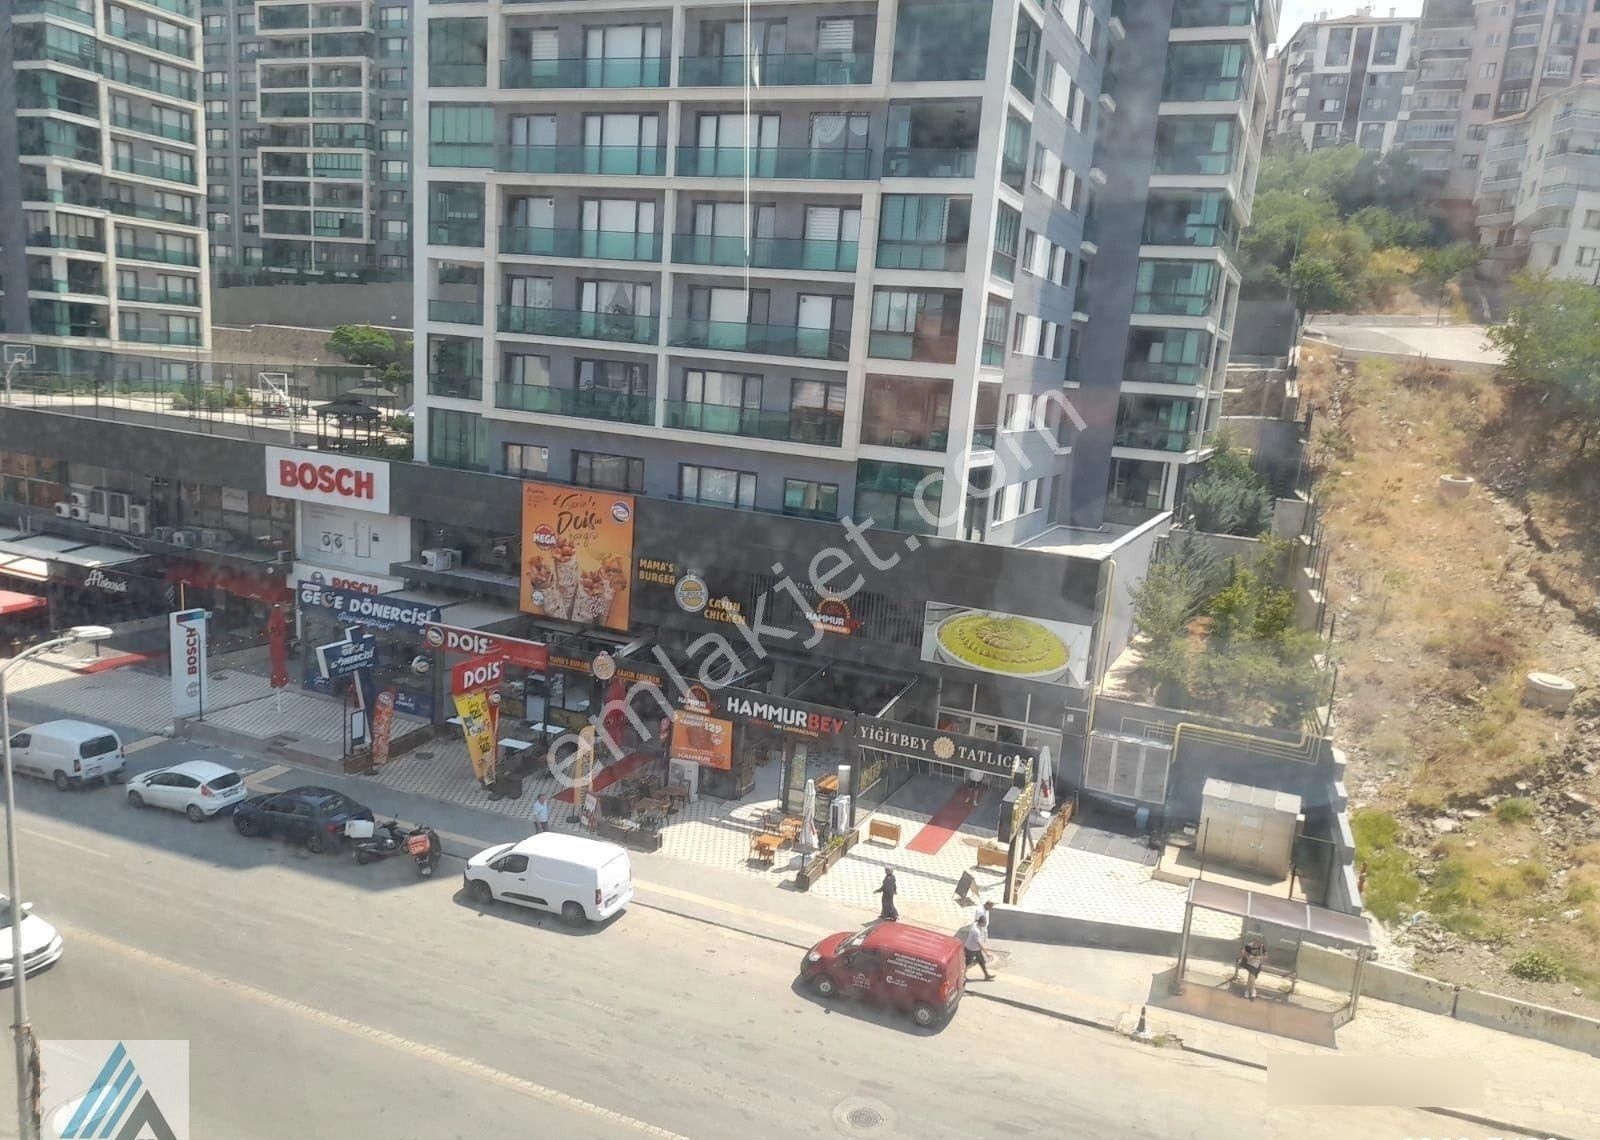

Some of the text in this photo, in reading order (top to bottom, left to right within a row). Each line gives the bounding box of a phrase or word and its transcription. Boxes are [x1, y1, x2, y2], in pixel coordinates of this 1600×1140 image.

[280, 460, 374, 500] BOSCH
[639, 558, 675, 573] MAMA'S
[639, 570, 676, 586] BURGER
[704, 609, 747, 626] CHICKEN
[805, 611, 846, 626] HAMMUR
[186, 627, 198, 675] BOSCH
